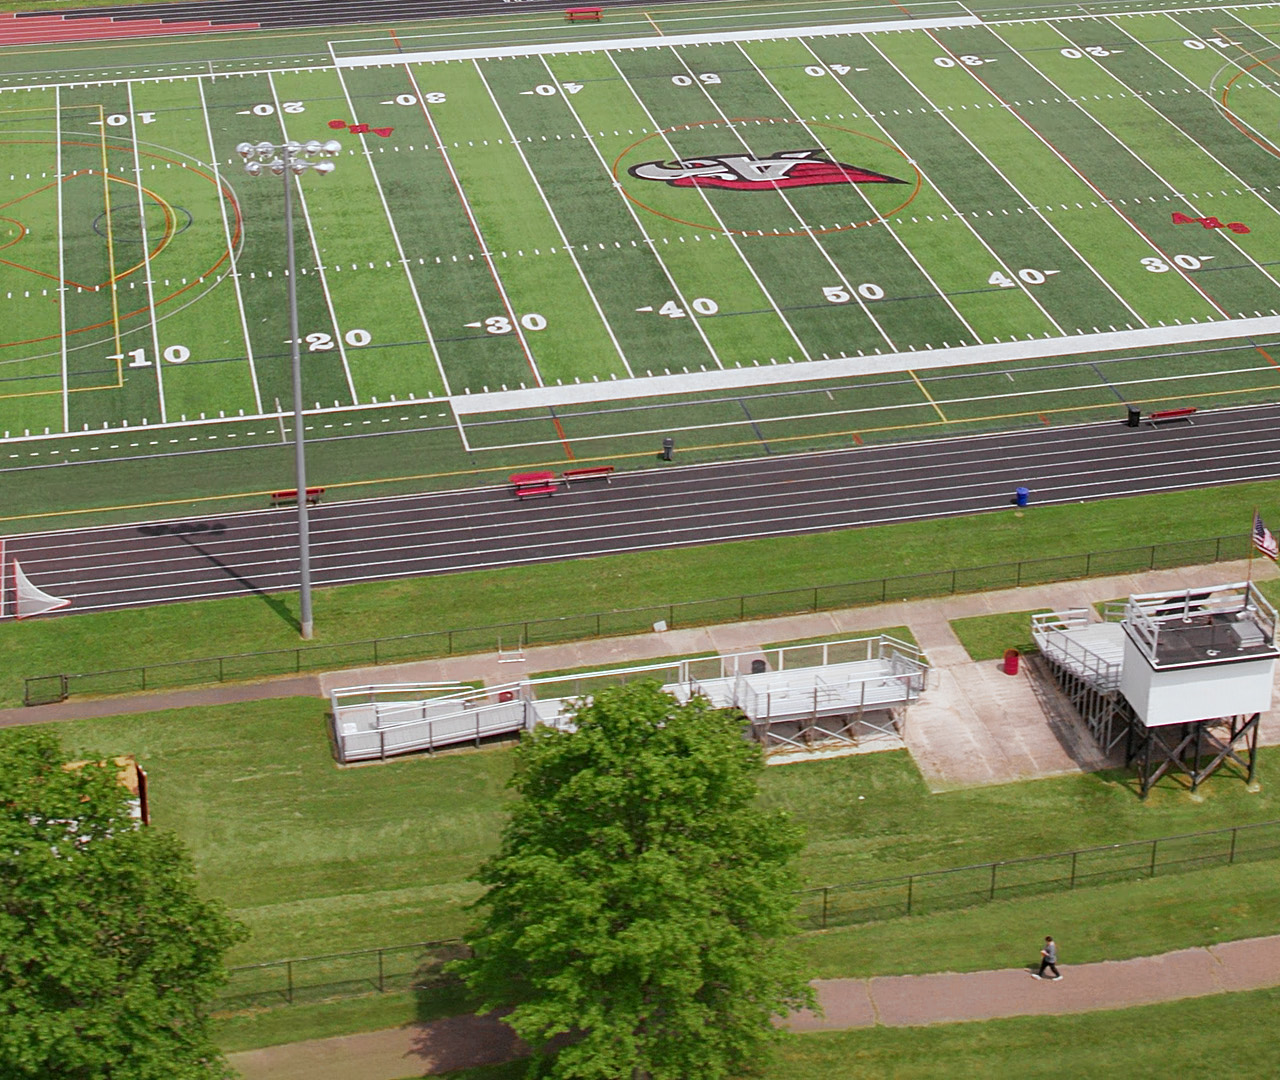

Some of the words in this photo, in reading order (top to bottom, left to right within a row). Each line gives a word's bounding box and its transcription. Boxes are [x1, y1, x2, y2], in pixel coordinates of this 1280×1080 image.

[1183, 38, 1230, 50] 10
[1060, 46, 1110, 59] 20
[934, 55, 983, 68] 30
[804, 64, 851, 77] 40
[671, 73, 722, 86] 50
[535, 82, 584, 96] 40
[396, 92, 446, 106] 30
[253, 101, 305, 116] 20
[106, 112, 156, 126] 10
[1140, 254, 1201, 272] 30
[988, 269, 1045, 288] 40
[822, 283, 884, 302] 50
[659, 298, 718, 319] 40
[485, 313, 547, 334] 30
[305, 329, 371, 351] 20
[128, 345, 190, 367] 10
